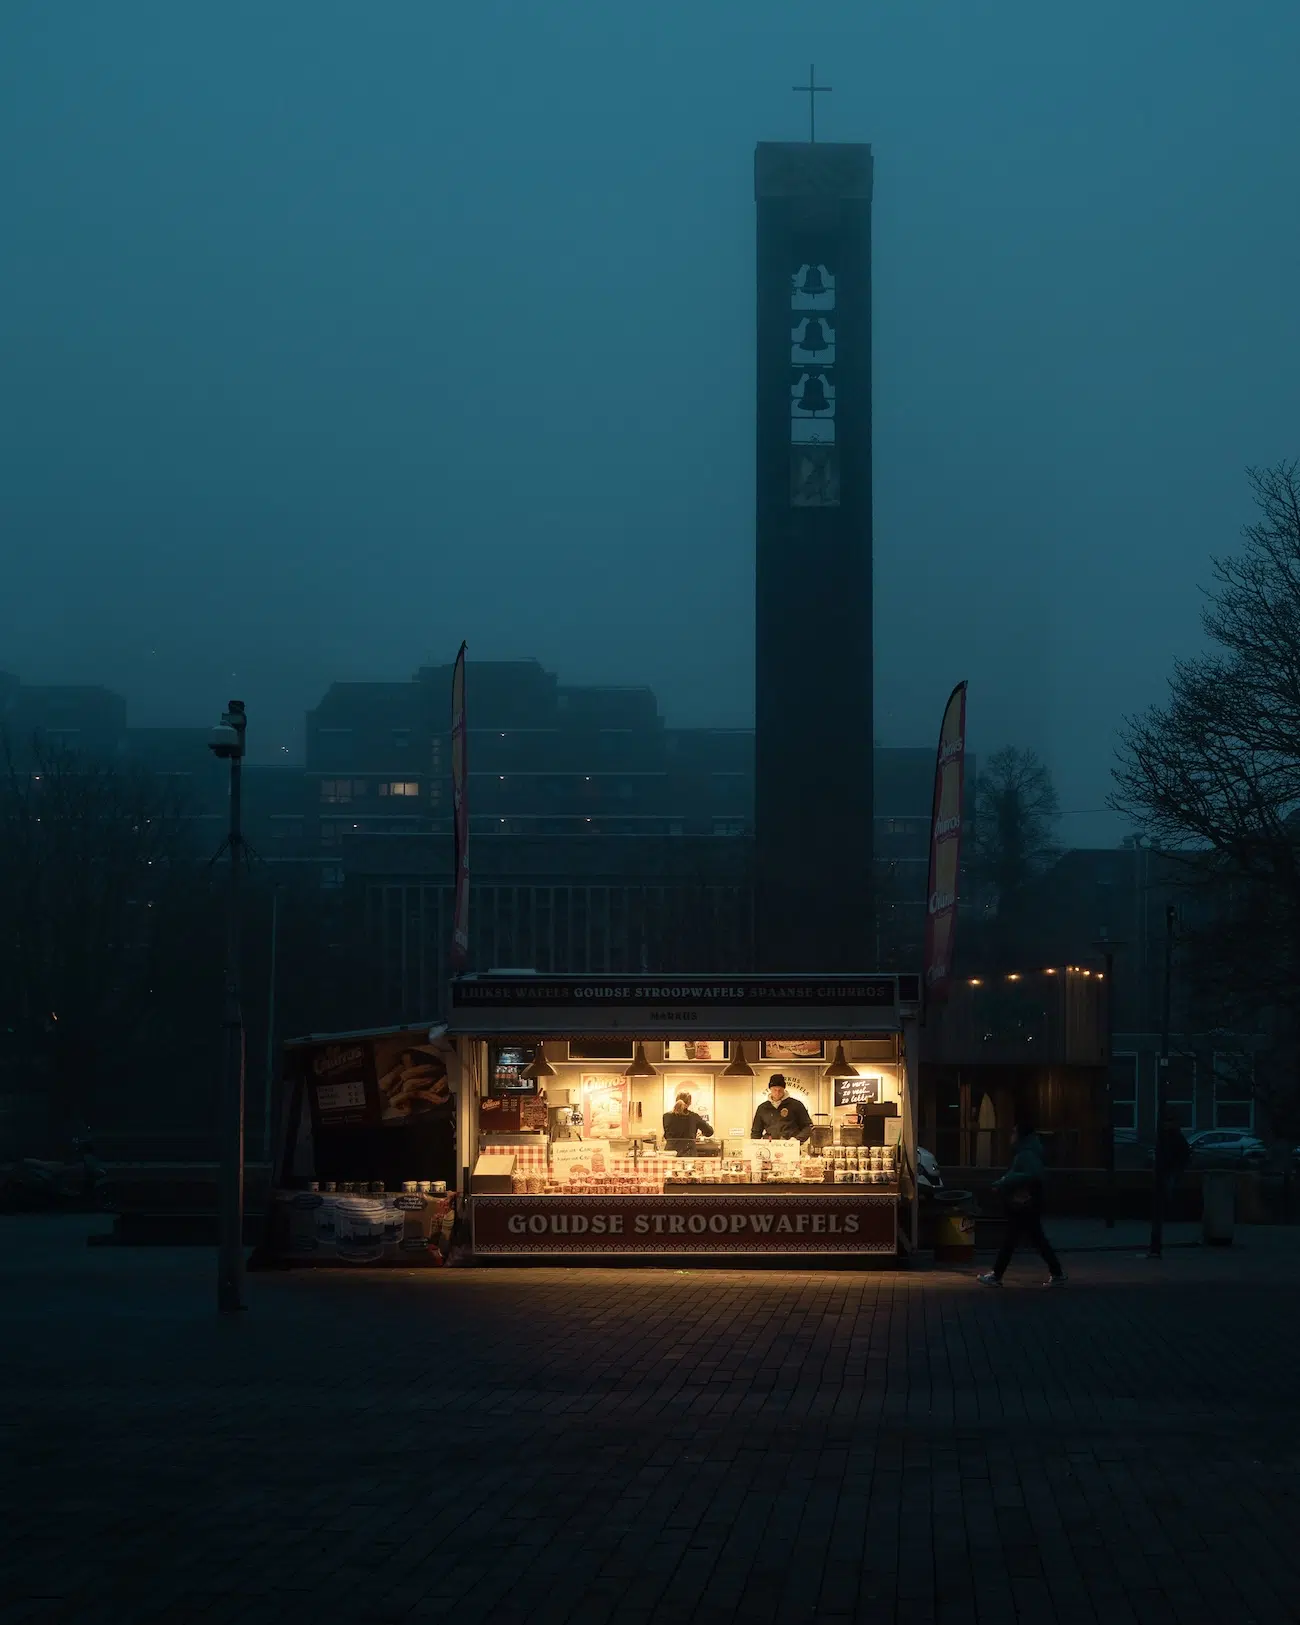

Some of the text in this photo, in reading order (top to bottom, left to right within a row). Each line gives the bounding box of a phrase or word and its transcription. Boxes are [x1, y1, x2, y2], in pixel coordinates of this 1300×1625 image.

[515, 987, 569, 998] WAFELS
[573, 986, 631, 998] GOUDSE
[634, 986, 745, 998] STROOPWAFELS
[749, 986, 813, 998] SPAANSE
[817, 986, 885, 998] CHURROS
[840, 1080, 850, 1090] Zo
[507, 1213, 861, 1235] GOUDSE STROOPWAFELS
